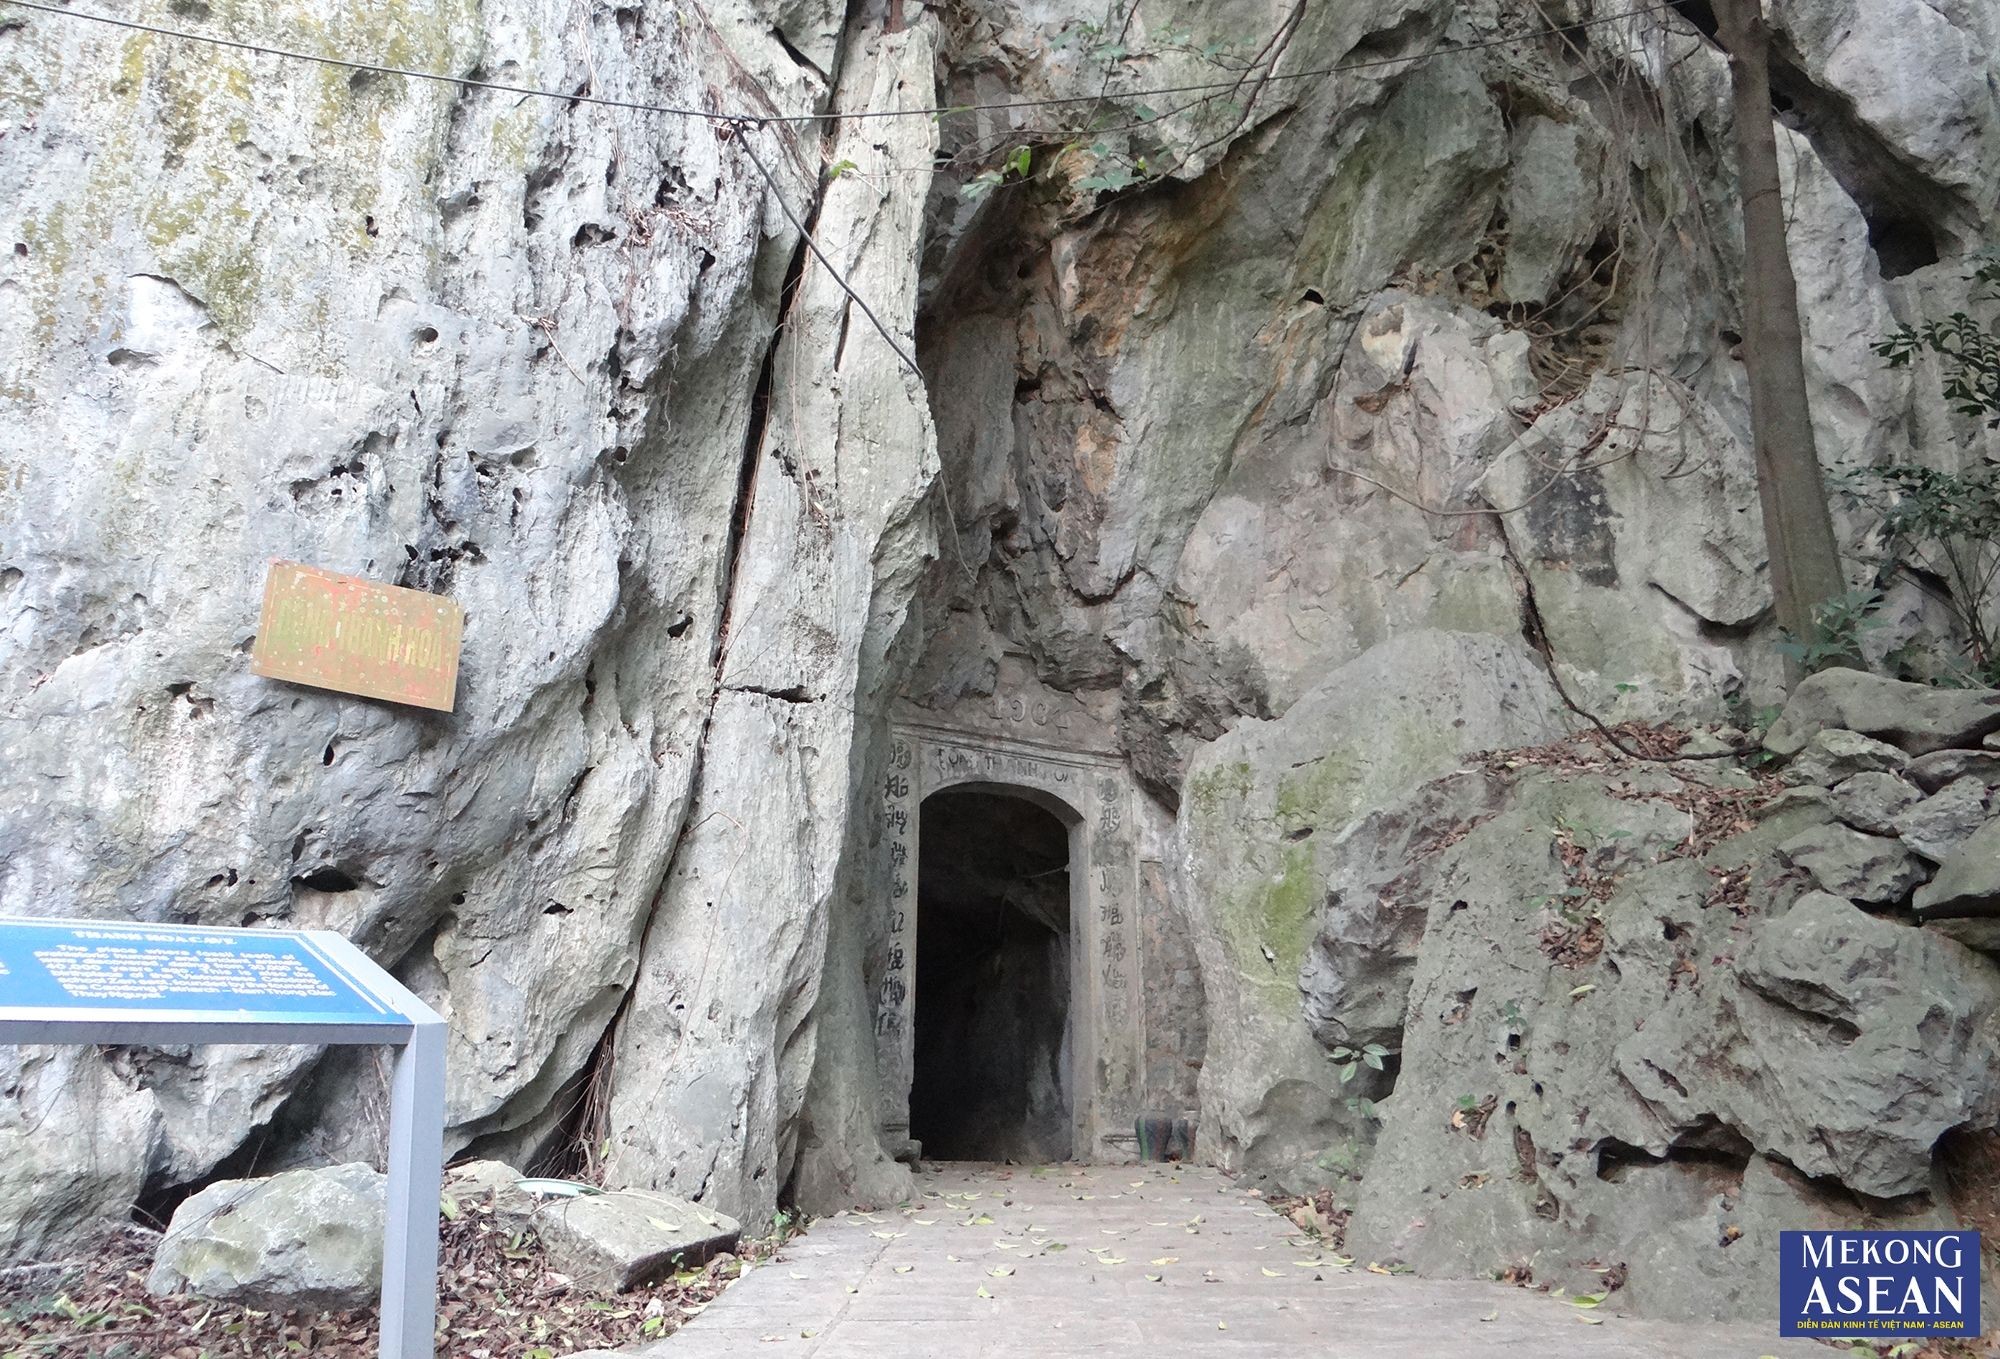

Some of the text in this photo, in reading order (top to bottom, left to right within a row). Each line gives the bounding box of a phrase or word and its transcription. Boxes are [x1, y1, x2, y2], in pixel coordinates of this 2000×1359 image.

[113, 953, 169, 961] humans
[168, 961, 210, 969] dating
[172, 979, 228, 987] founded
